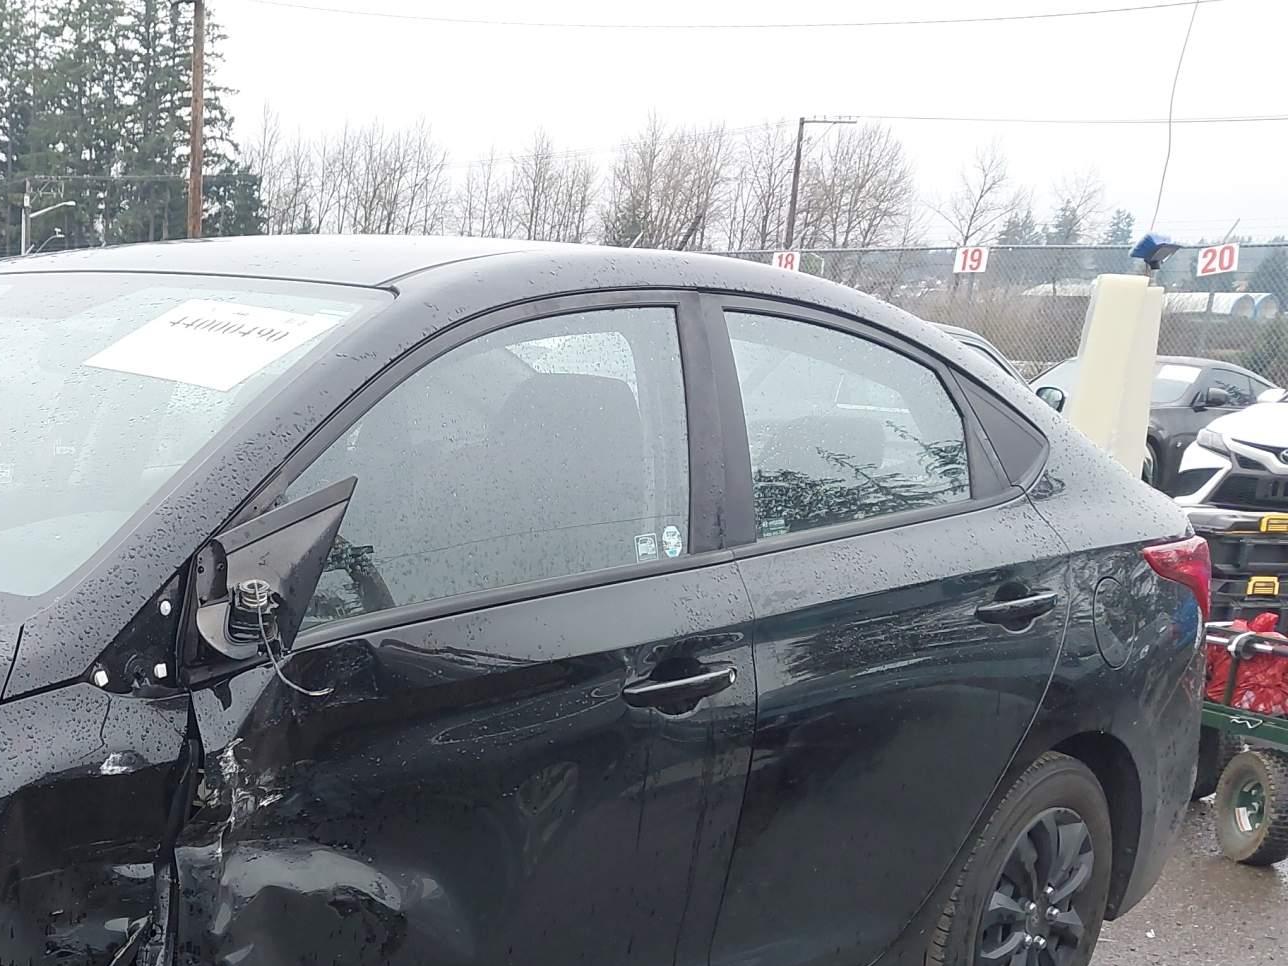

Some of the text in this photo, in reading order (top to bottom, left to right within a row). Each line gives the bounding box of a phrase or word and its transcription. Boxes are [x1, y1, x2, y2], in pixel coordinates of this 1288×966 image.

[777, 252, 795, 270] 18
[961, 248, 983, 271] 19
[1201, 245, 1235, 274] 20
